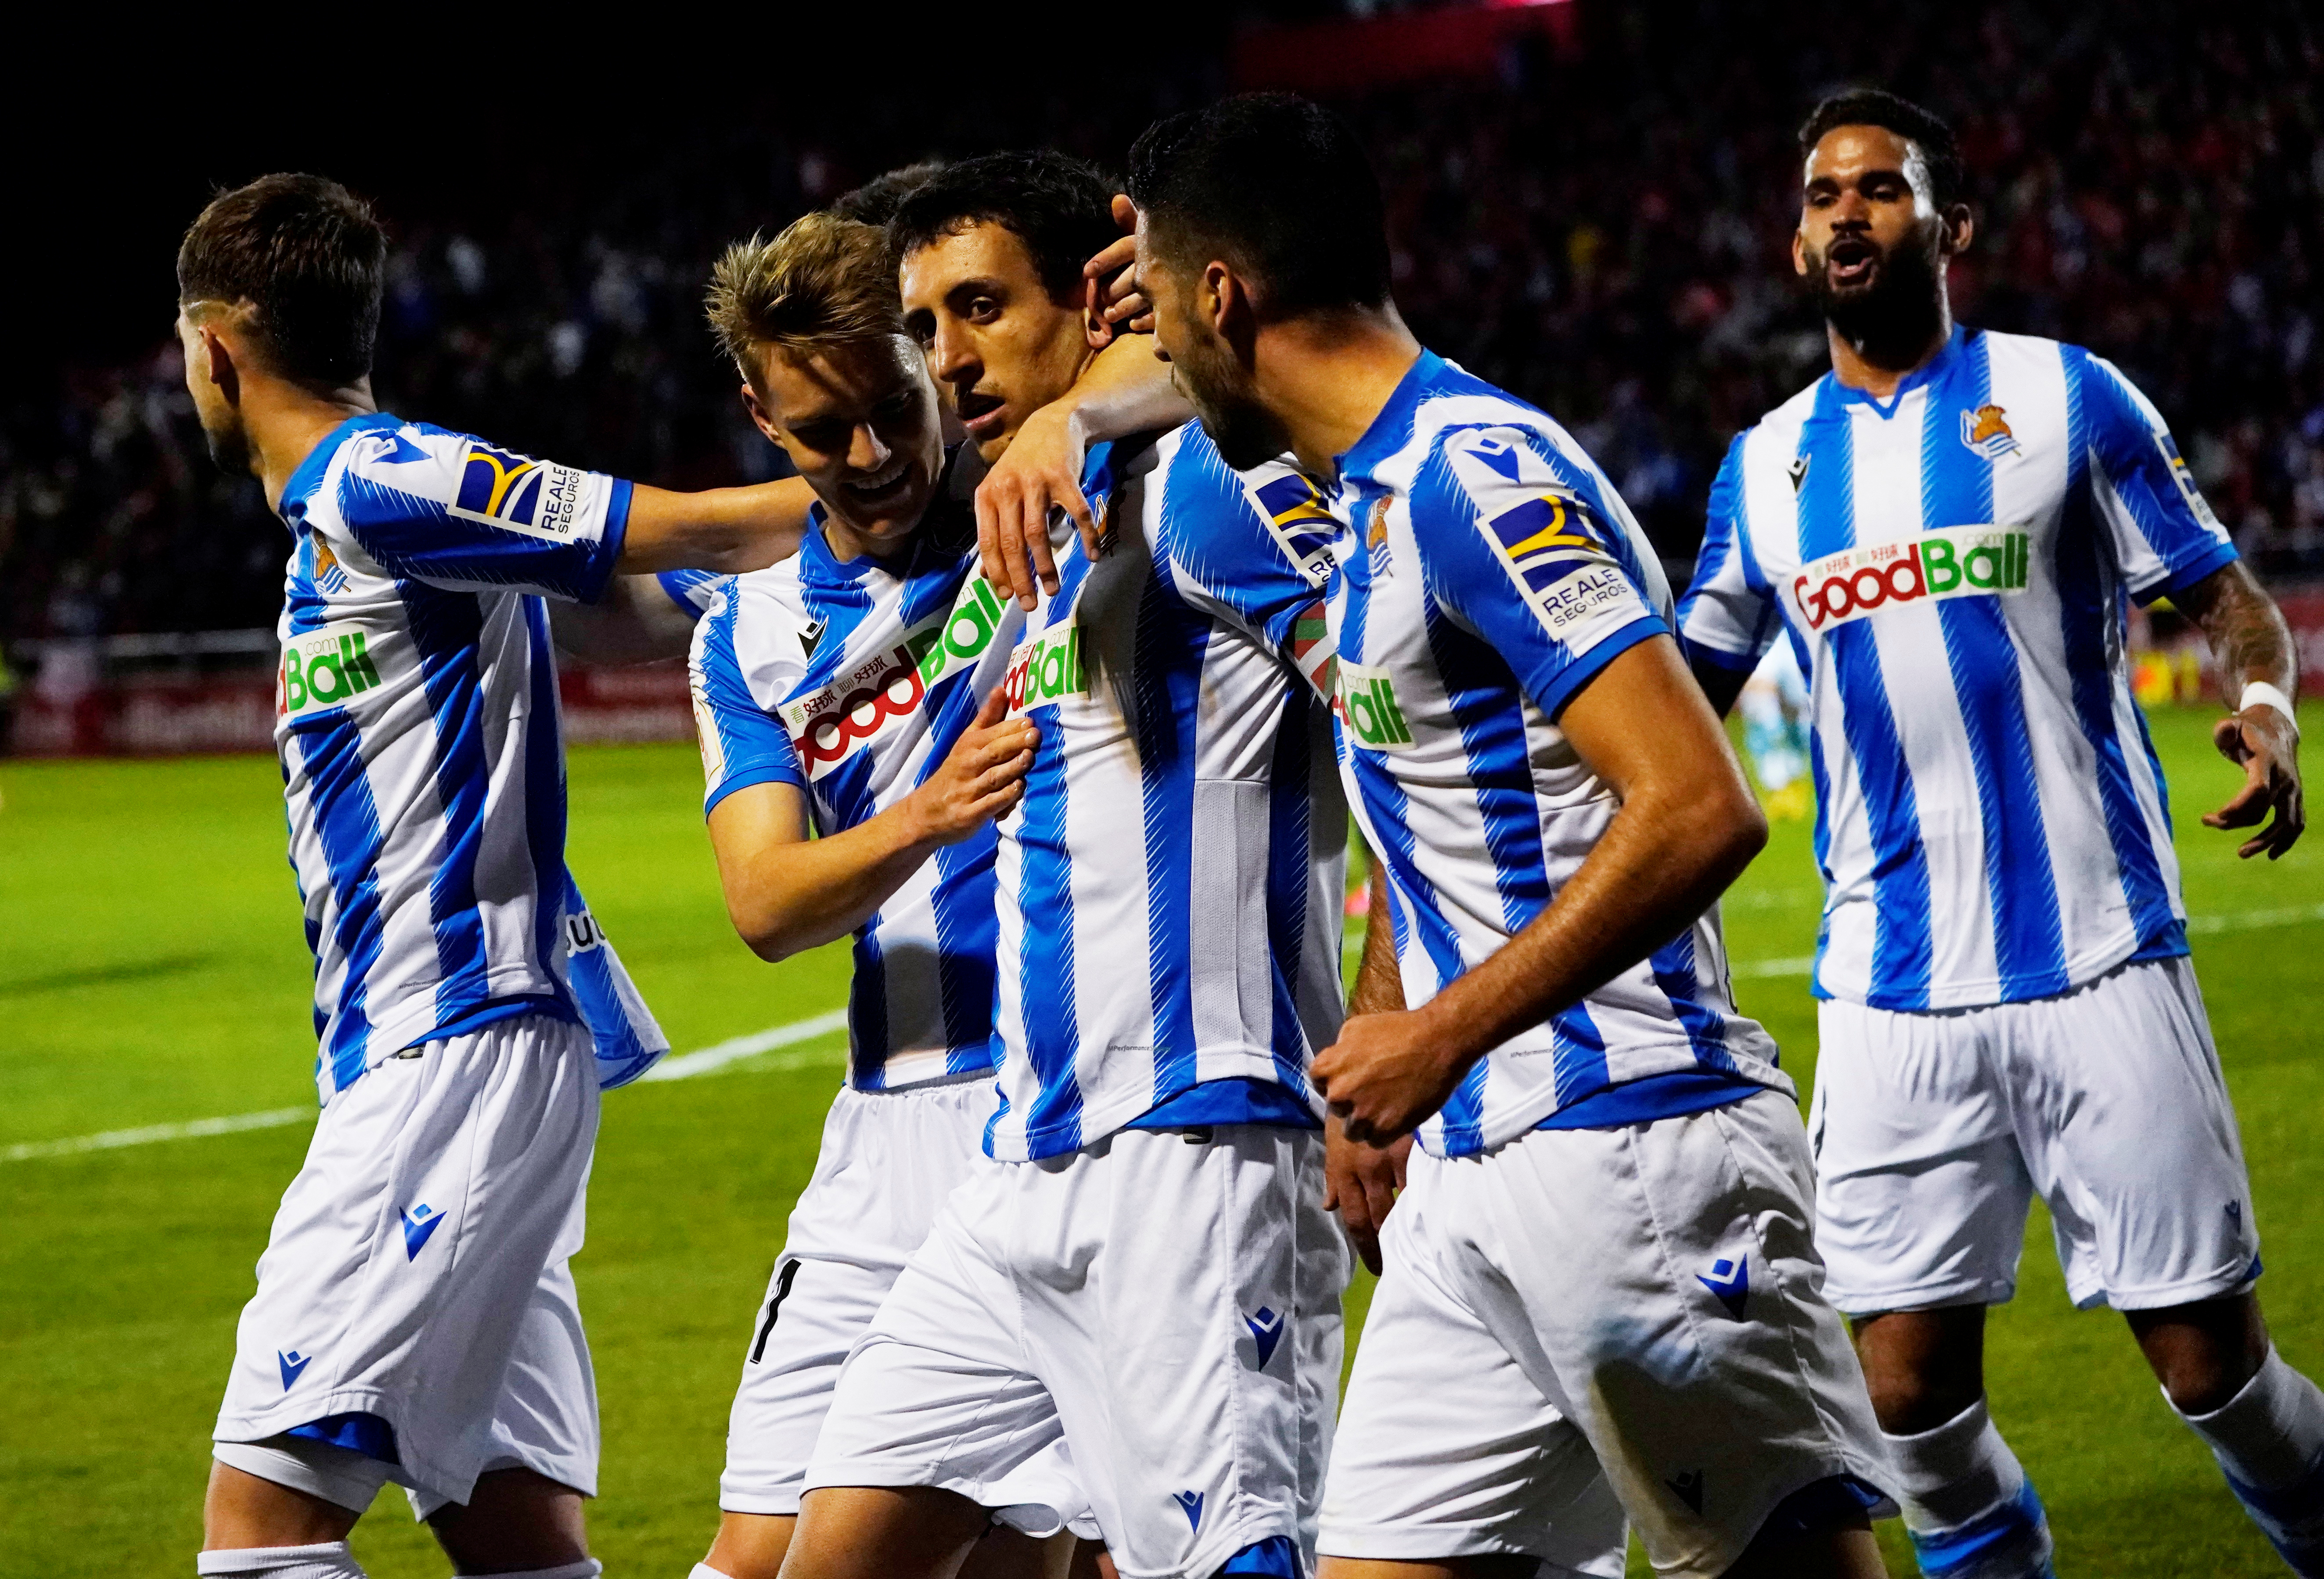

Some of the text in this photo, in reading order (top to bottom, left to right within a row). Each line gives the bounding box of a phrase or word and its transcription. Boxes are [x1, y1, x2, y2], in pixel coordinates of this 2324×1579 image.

[541, 467, 567, 531] REALE
[559, 471, 579, 534] SEGUROS
[1309, 553, 1337, 575] RE
[1795, 533, 2028, 630] GoodBall
[1542, 569, 1619, 615] REALE
[1554, 583, 1628, 627] SEGUROS
[305, 638, 338, 656] .com
[1047, 628, 1069, 646] .com
[803, 689, 838, 718] 好球
[854, 655, 889, 684] 好球
